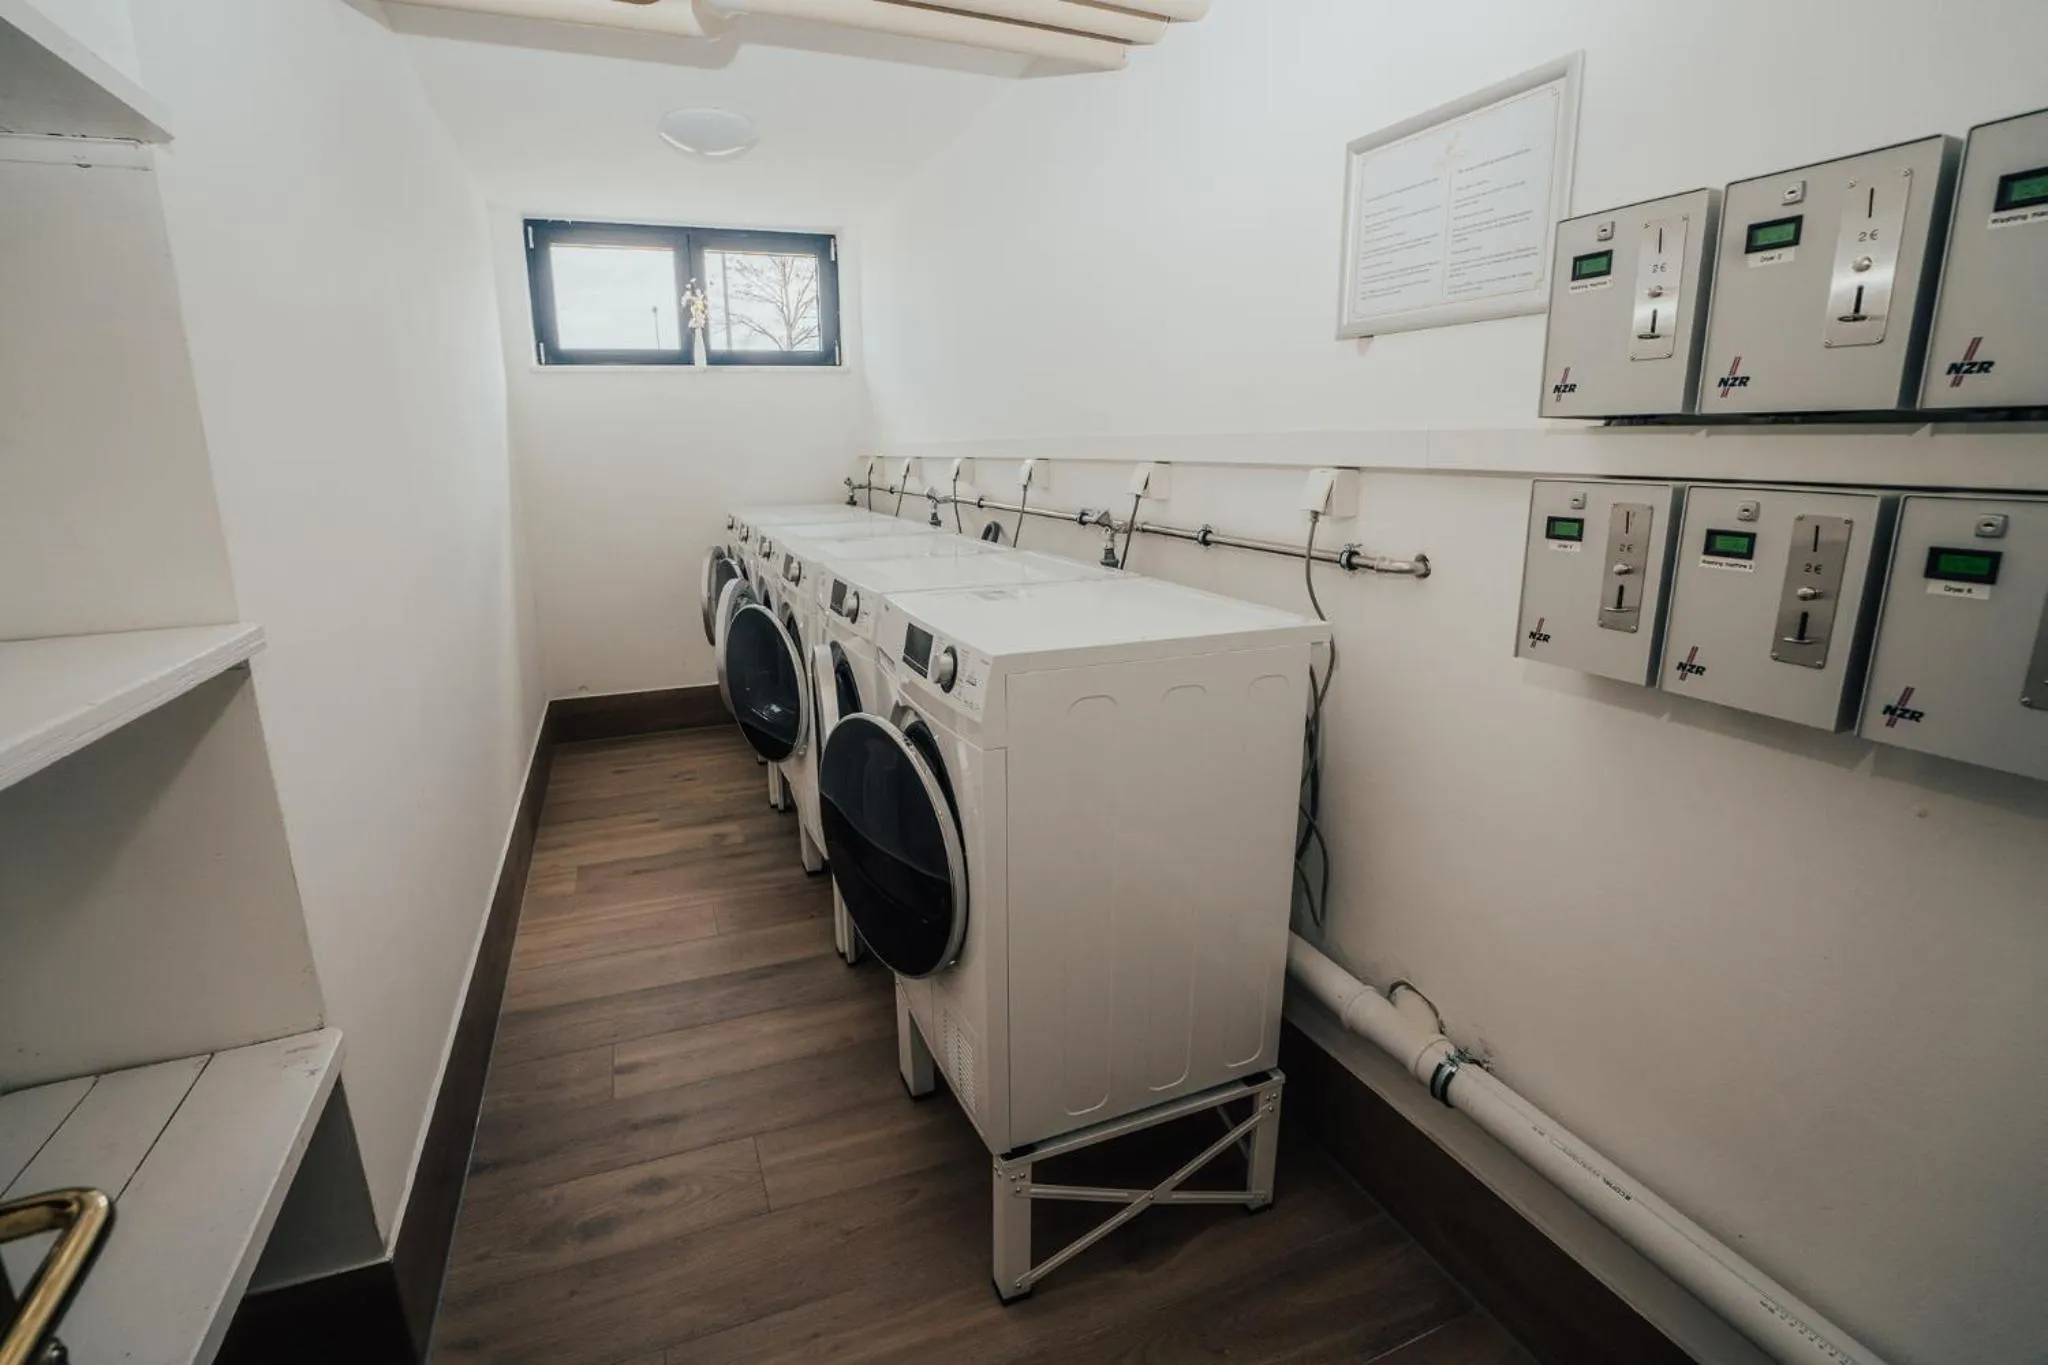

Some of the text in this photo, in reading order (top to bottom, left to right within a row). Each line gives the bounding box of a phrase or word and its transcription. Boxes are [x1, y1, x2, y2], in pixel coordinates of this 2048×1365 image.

[1945, 360, 1995, 376] NZR
[1552, 383, 1577, 394] NZR
[1717, 376, 1750, 388] NZR
[1528, 631, 1551, 643] NZR
[1676, 661, 1707, 676] NZR
[1882, 704, 1925, 723] NZR
